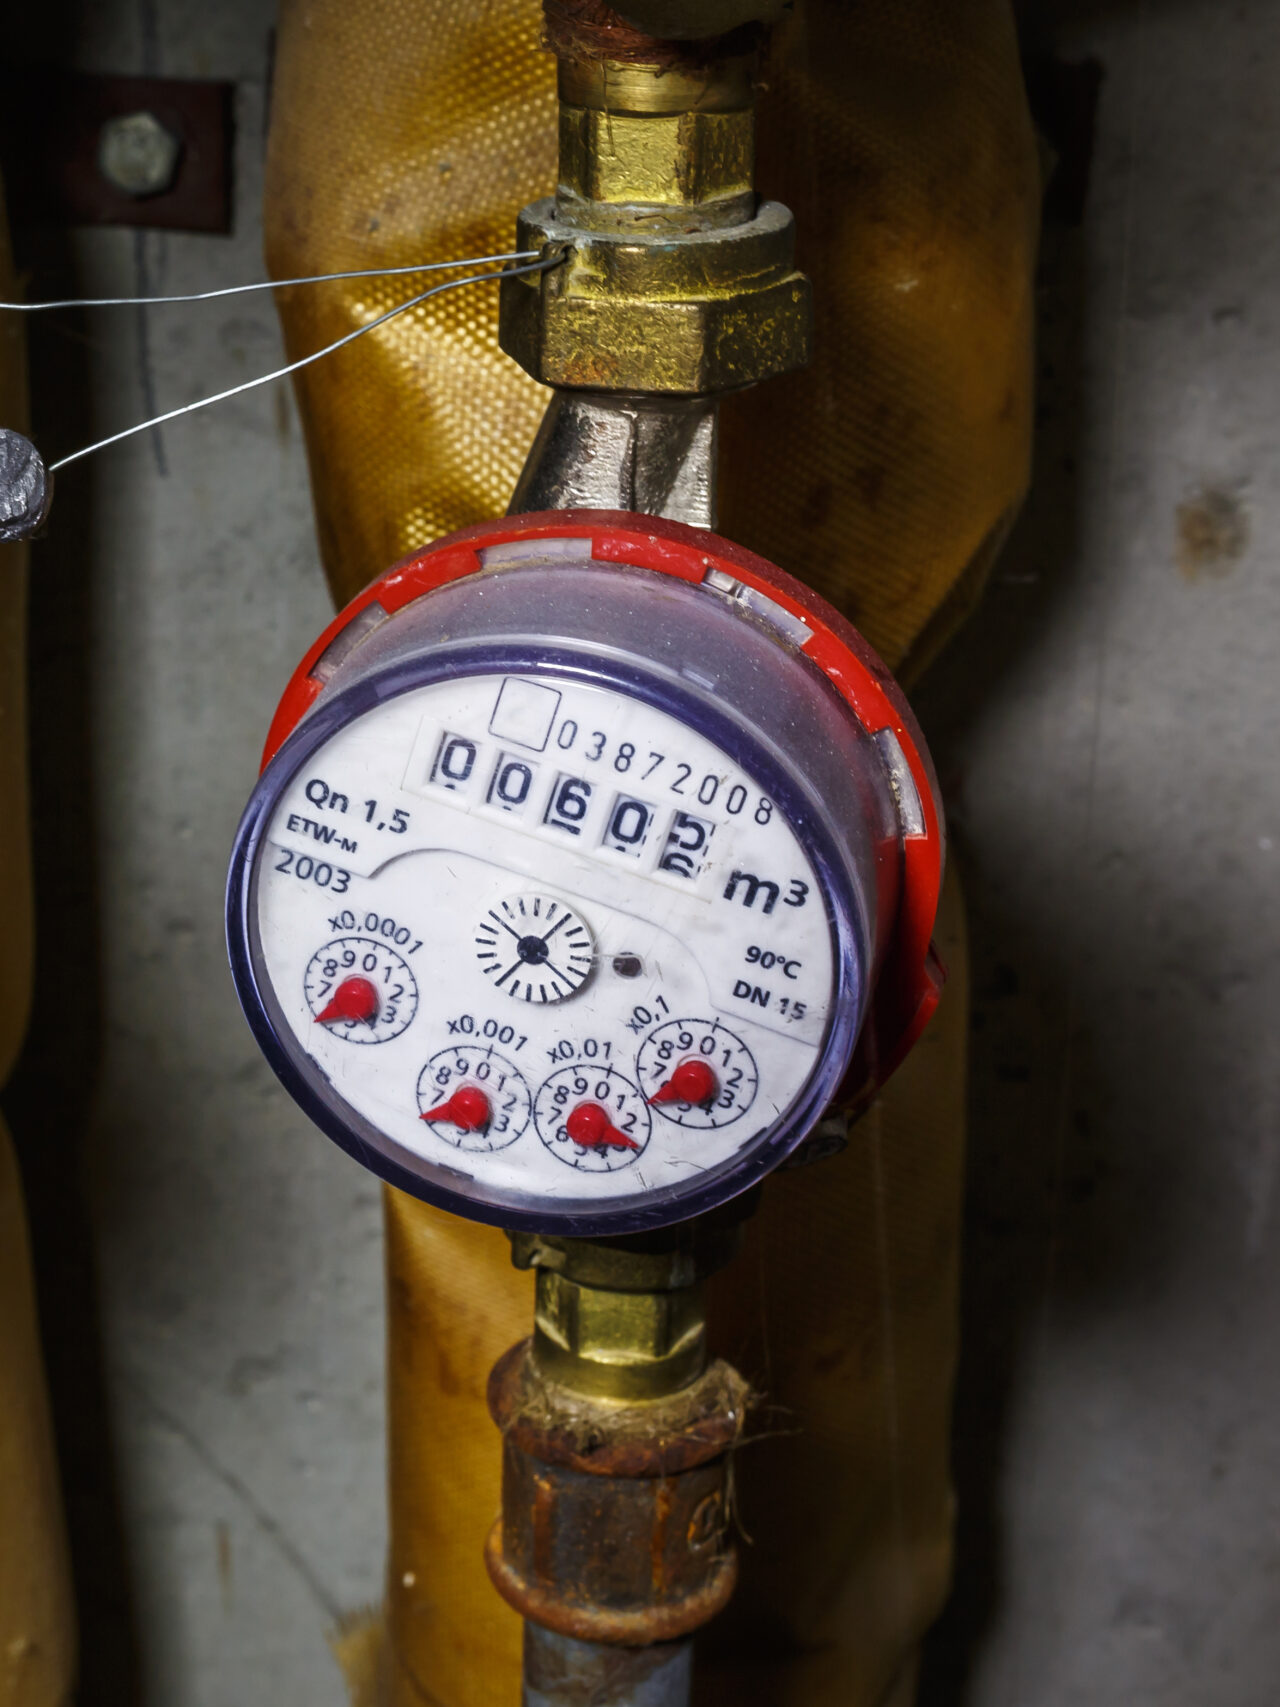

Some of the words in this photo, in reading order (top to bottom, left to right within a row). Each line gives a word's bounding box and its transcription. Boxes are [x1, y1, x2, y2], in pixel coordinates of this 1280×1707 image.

[557, 719, 773, 826] 03872008
[305, 779, 350, 813] Qn
[365, 799, 411, 834] 1,5
[286, 813, 358, 853] ETW-M
[275, 849, 351, 893] 2003
[322, 958, 339, 977] 8
[340, 950, 356, 968] 9
[362, 953, 378, 972] 0
[383, 966, 394, 984] 1
[317, 979, 333, 998] 7
[388, 984, 404, 1004] 2
[732, 980, 771, 1008] DN
[779, 997, 807, 1020] 15
[381, 1005, 397, 1024] 3
[657, 1040, 675, 1060] 8
[676, 1032, 694, 1051] 9
[699, 1036, 716, 1055] 0
[454, 1058, 470, 1076] 9
[721, 1049, 733, 1067] 1
[435, 1065, 452, 1086] 8
[475, 1061, 491, 1081] 0
[651, 1061, 667, 1080] 7
[726, 1067, 744, 1088] 2
[497, 1074, 507, 1092] 1
[571, 1077, 588, 1095] 9
[594, 1081, 610, 1100] 0
[429, 1088, 446, 1106] 7
[501, 1092, 518, 1112] 2
[553, 1085, 570, 1105] 8
[616, 1094, 627, 1112] 1
[718, 1089, 736, 1109] 3
[494, 1114, 510, 1133] 3
[547, 1106, 562, 1125] 7
[621, 1112, 638, 1133] 2
